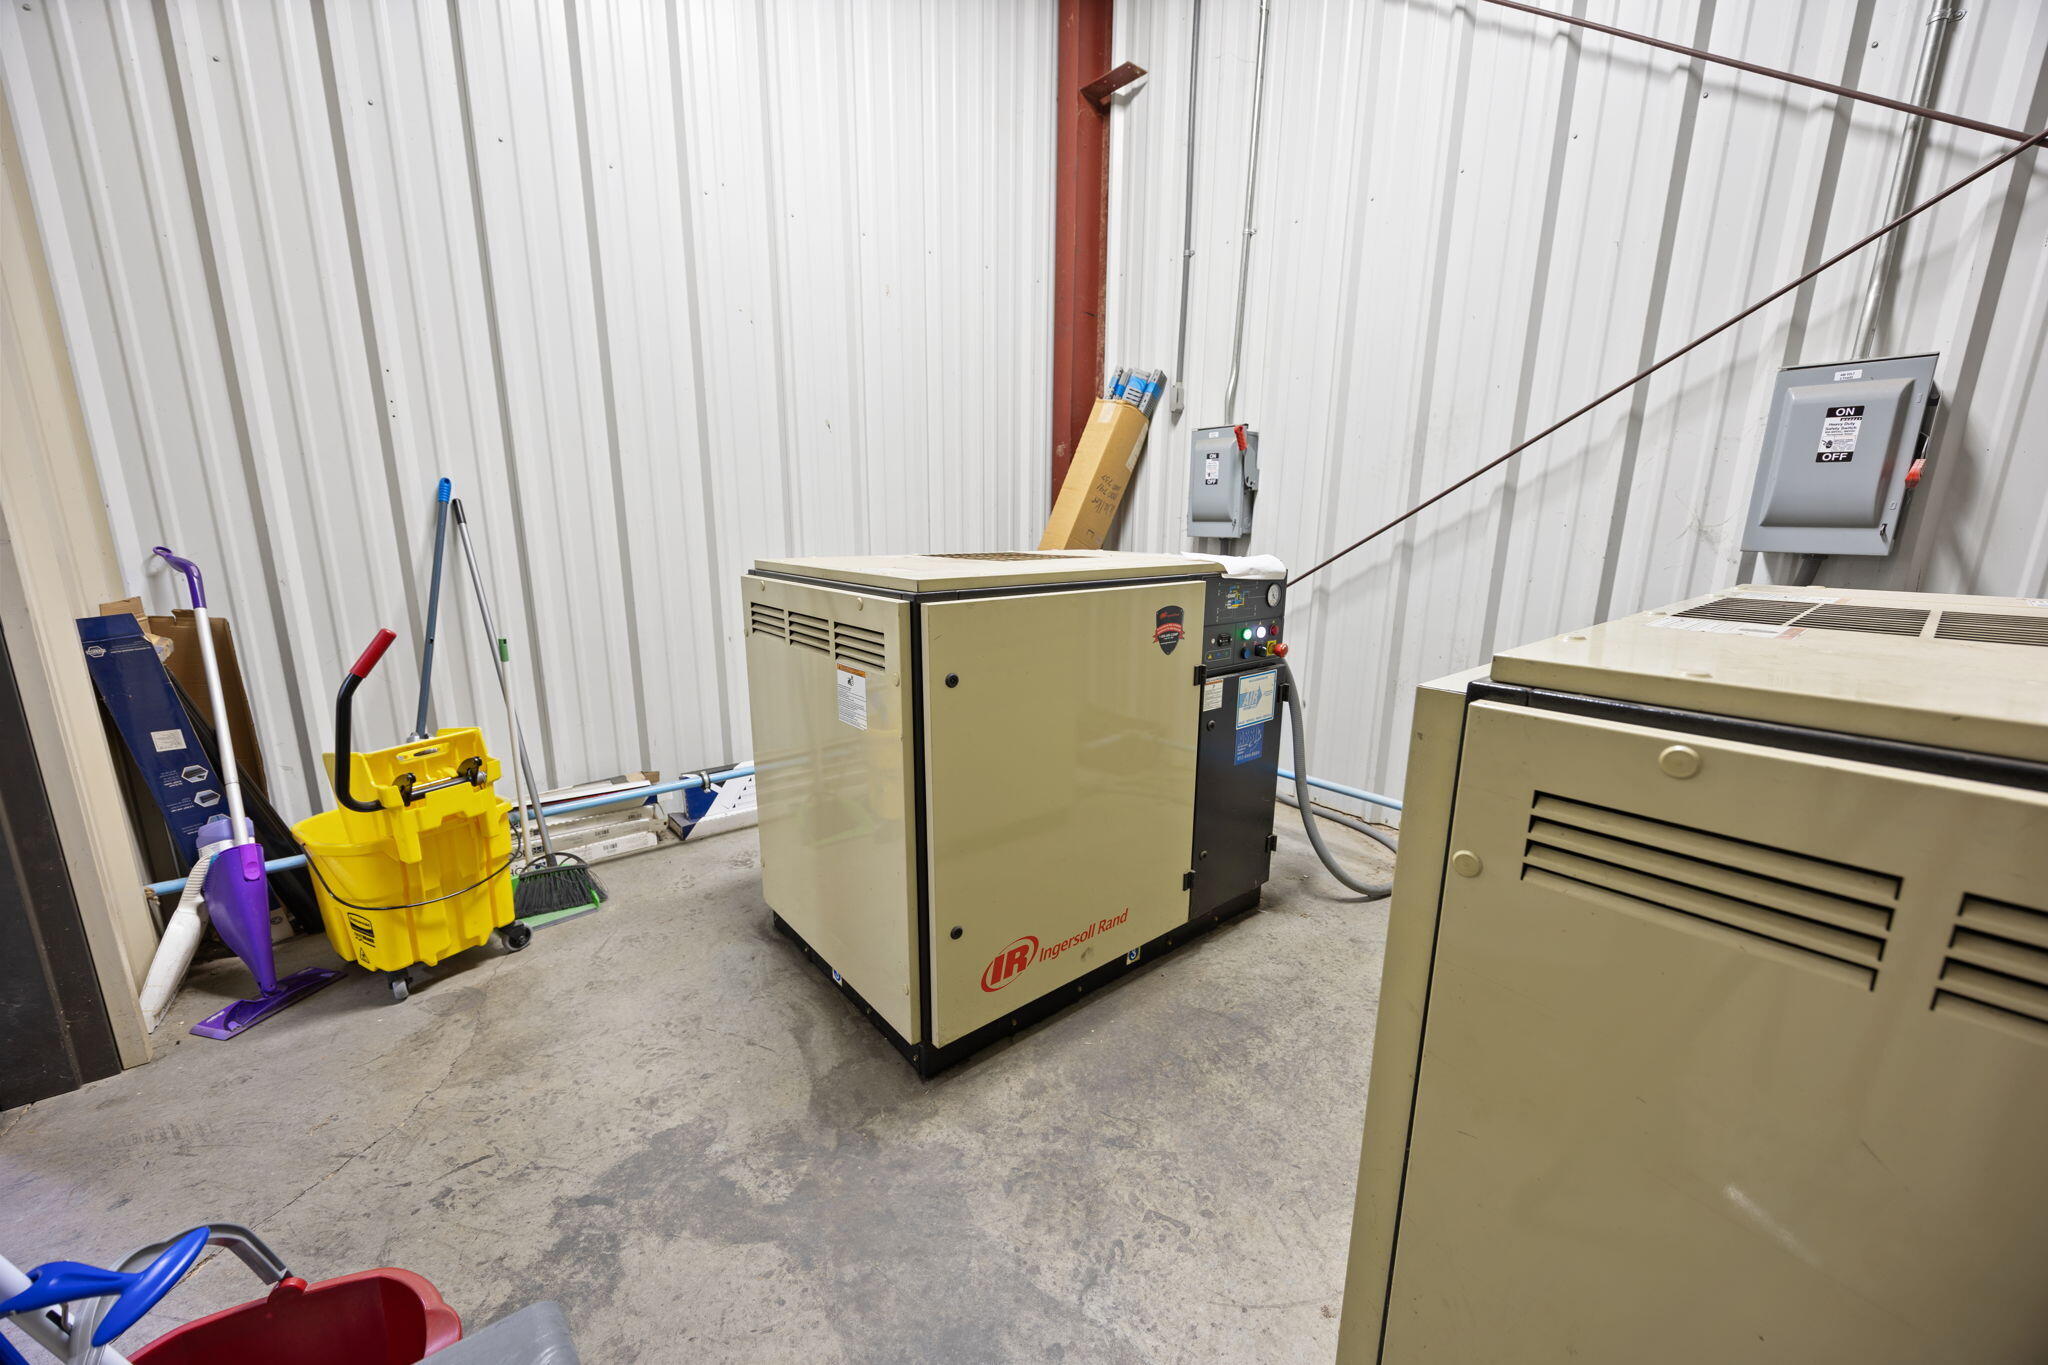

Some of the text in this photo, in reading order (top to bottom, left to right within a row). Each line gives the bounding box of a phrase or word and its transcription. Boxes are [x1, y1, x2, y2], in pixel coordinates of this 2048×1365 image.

[1835, 407, 1855, 416] ON
[1822, 452, 1848, 461] OFF
[989, 908, 1129, 986] IR Ingersoll Rand
